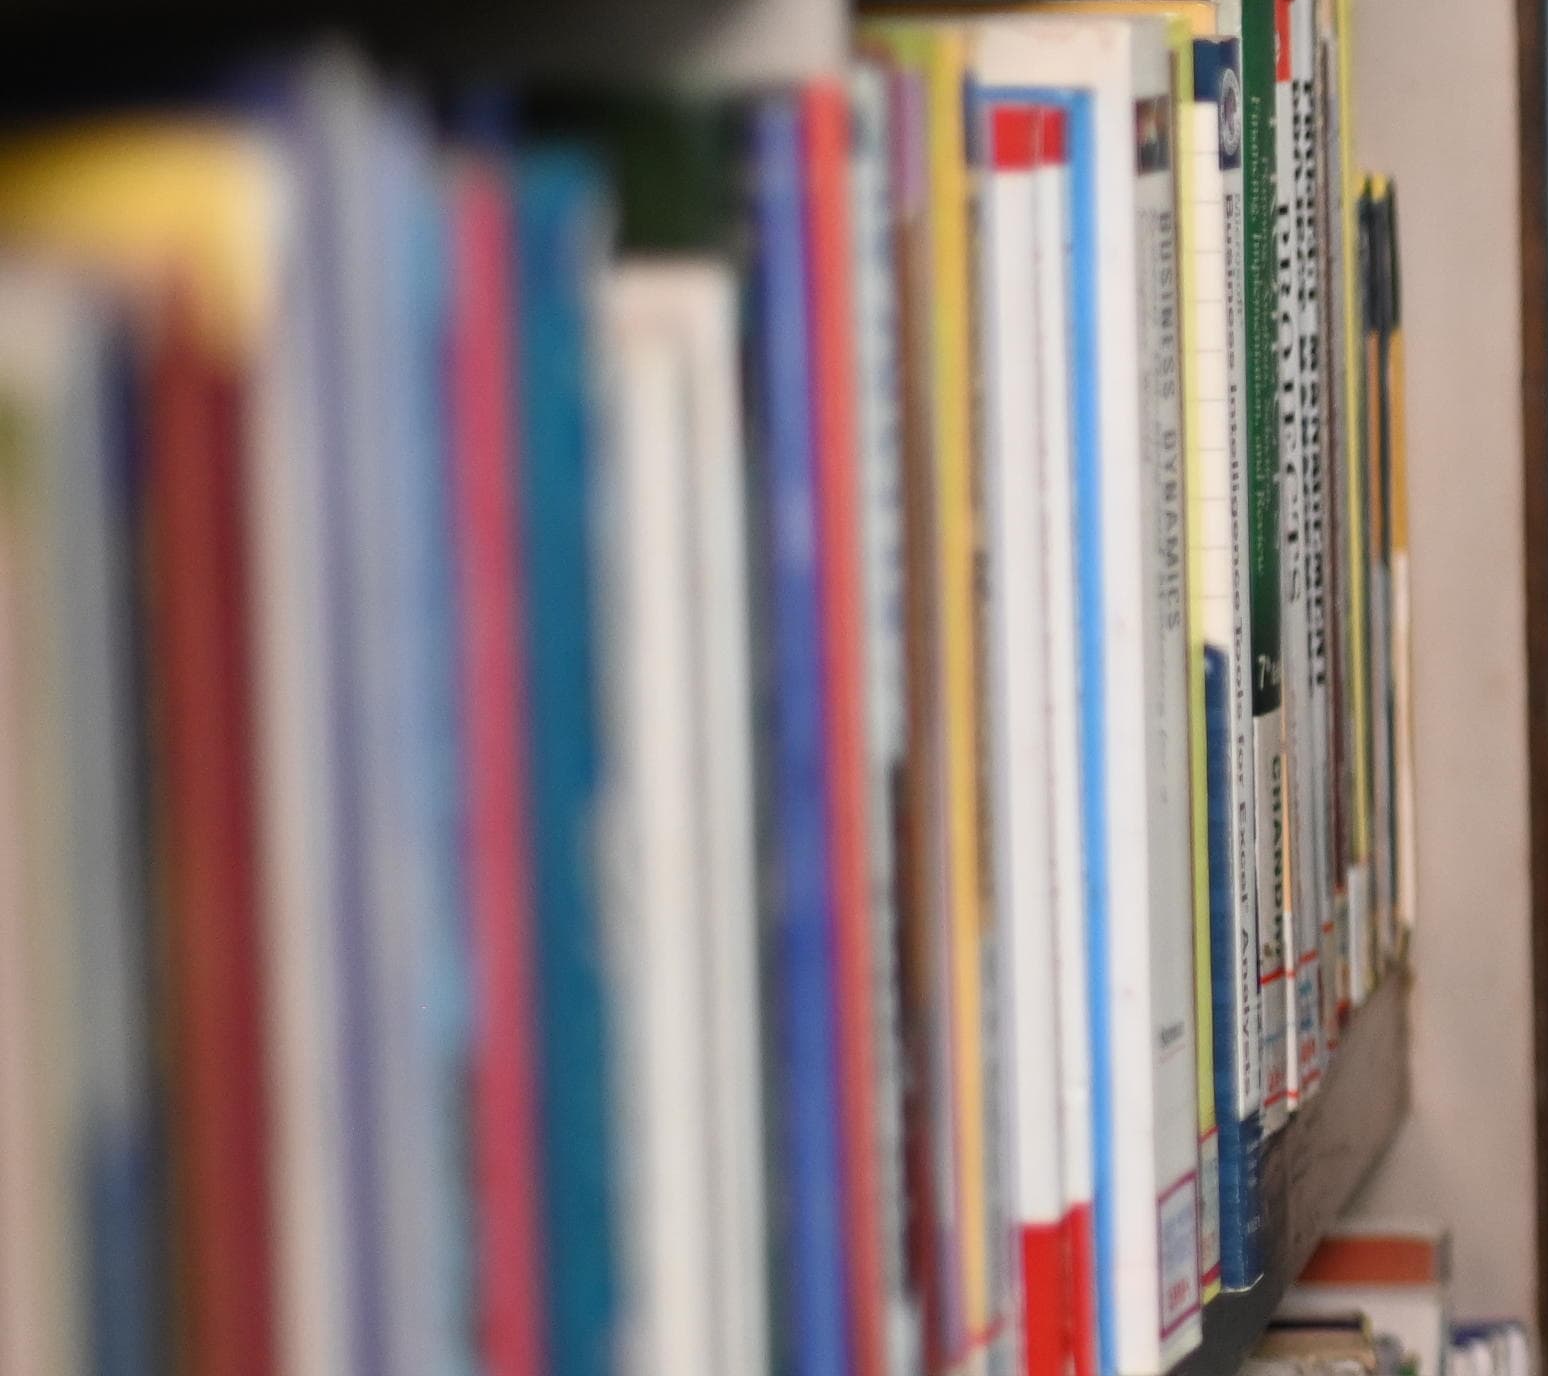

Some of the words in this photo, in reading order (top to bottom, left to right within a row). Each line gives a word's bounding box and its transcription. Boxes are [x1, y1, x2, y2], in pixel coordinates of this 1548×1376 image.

[1159, 208, 1175, 401] BUSINESS
[1225, 193, 1235, 370] Business
[1164, 428, 1180, 633] DYNAMICS
[1230, 383, 1240, 612] Intelligence
[1234, 617, 1244, 721] Tools
[1241, 929, 1252, 1098] Analysts
